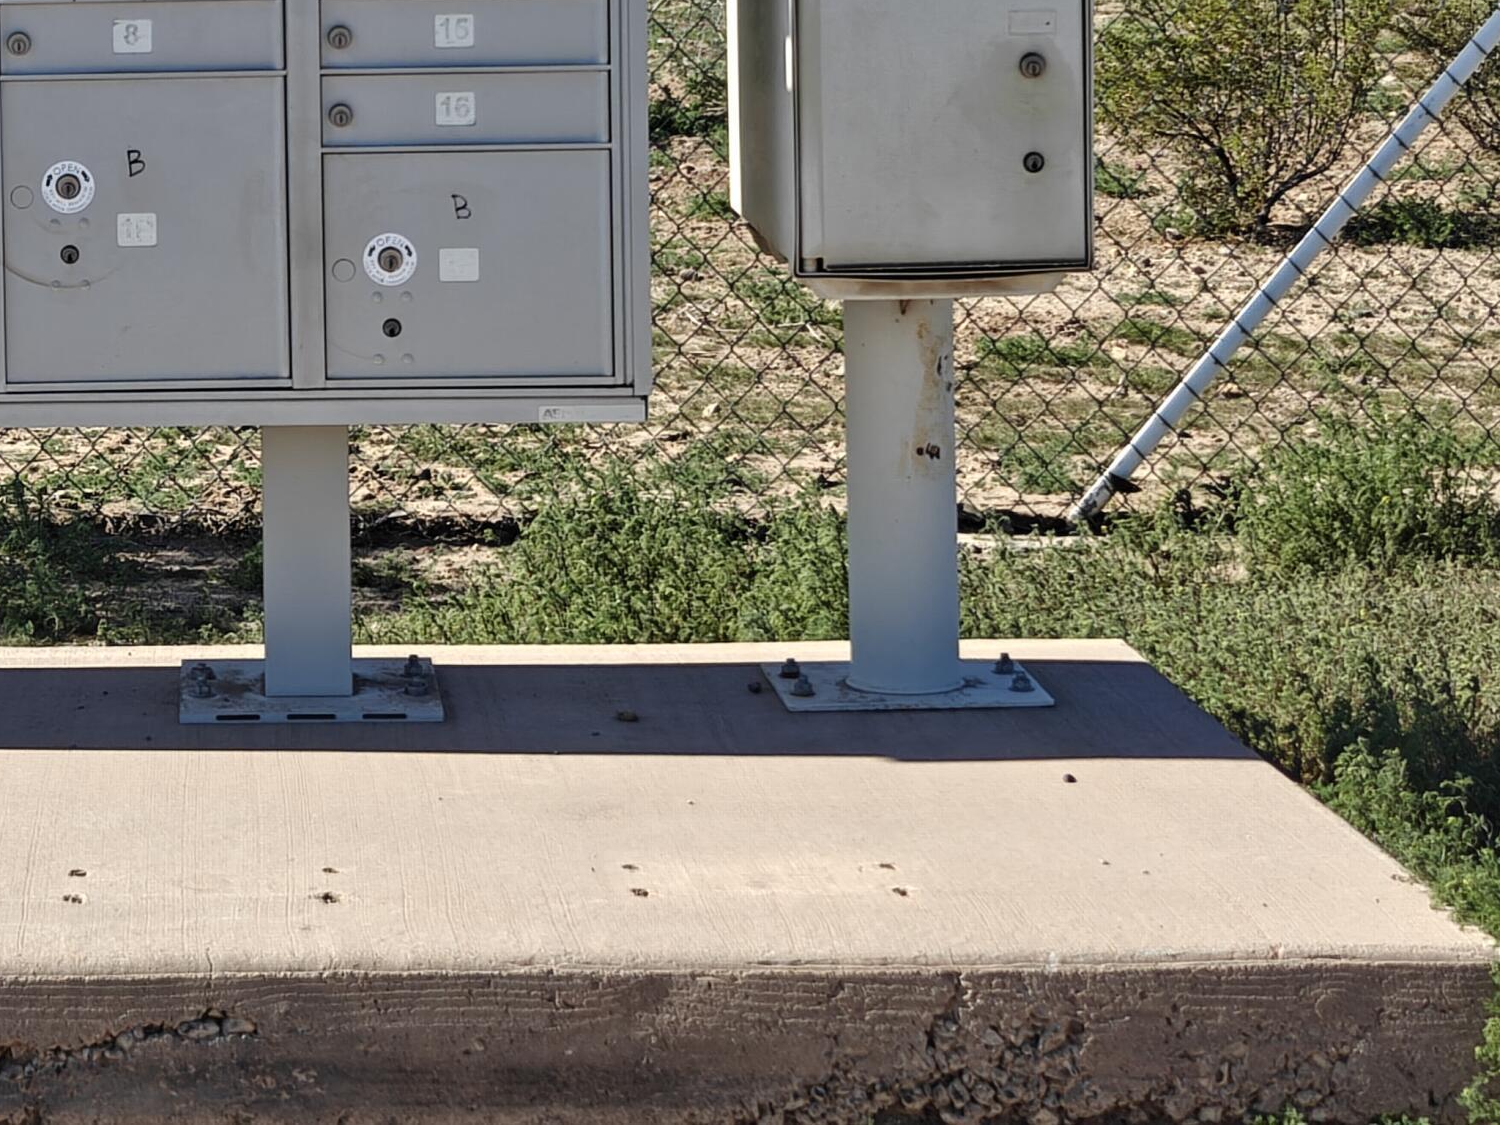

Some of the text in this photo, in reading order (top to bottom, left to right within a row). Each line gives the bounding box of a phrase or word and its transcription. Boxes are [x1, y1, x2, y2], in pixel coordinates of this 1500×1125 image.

[440, 96, 471, 119] 16
[126, 149, 146, 178] B
[451, 194, 472, 220] B
